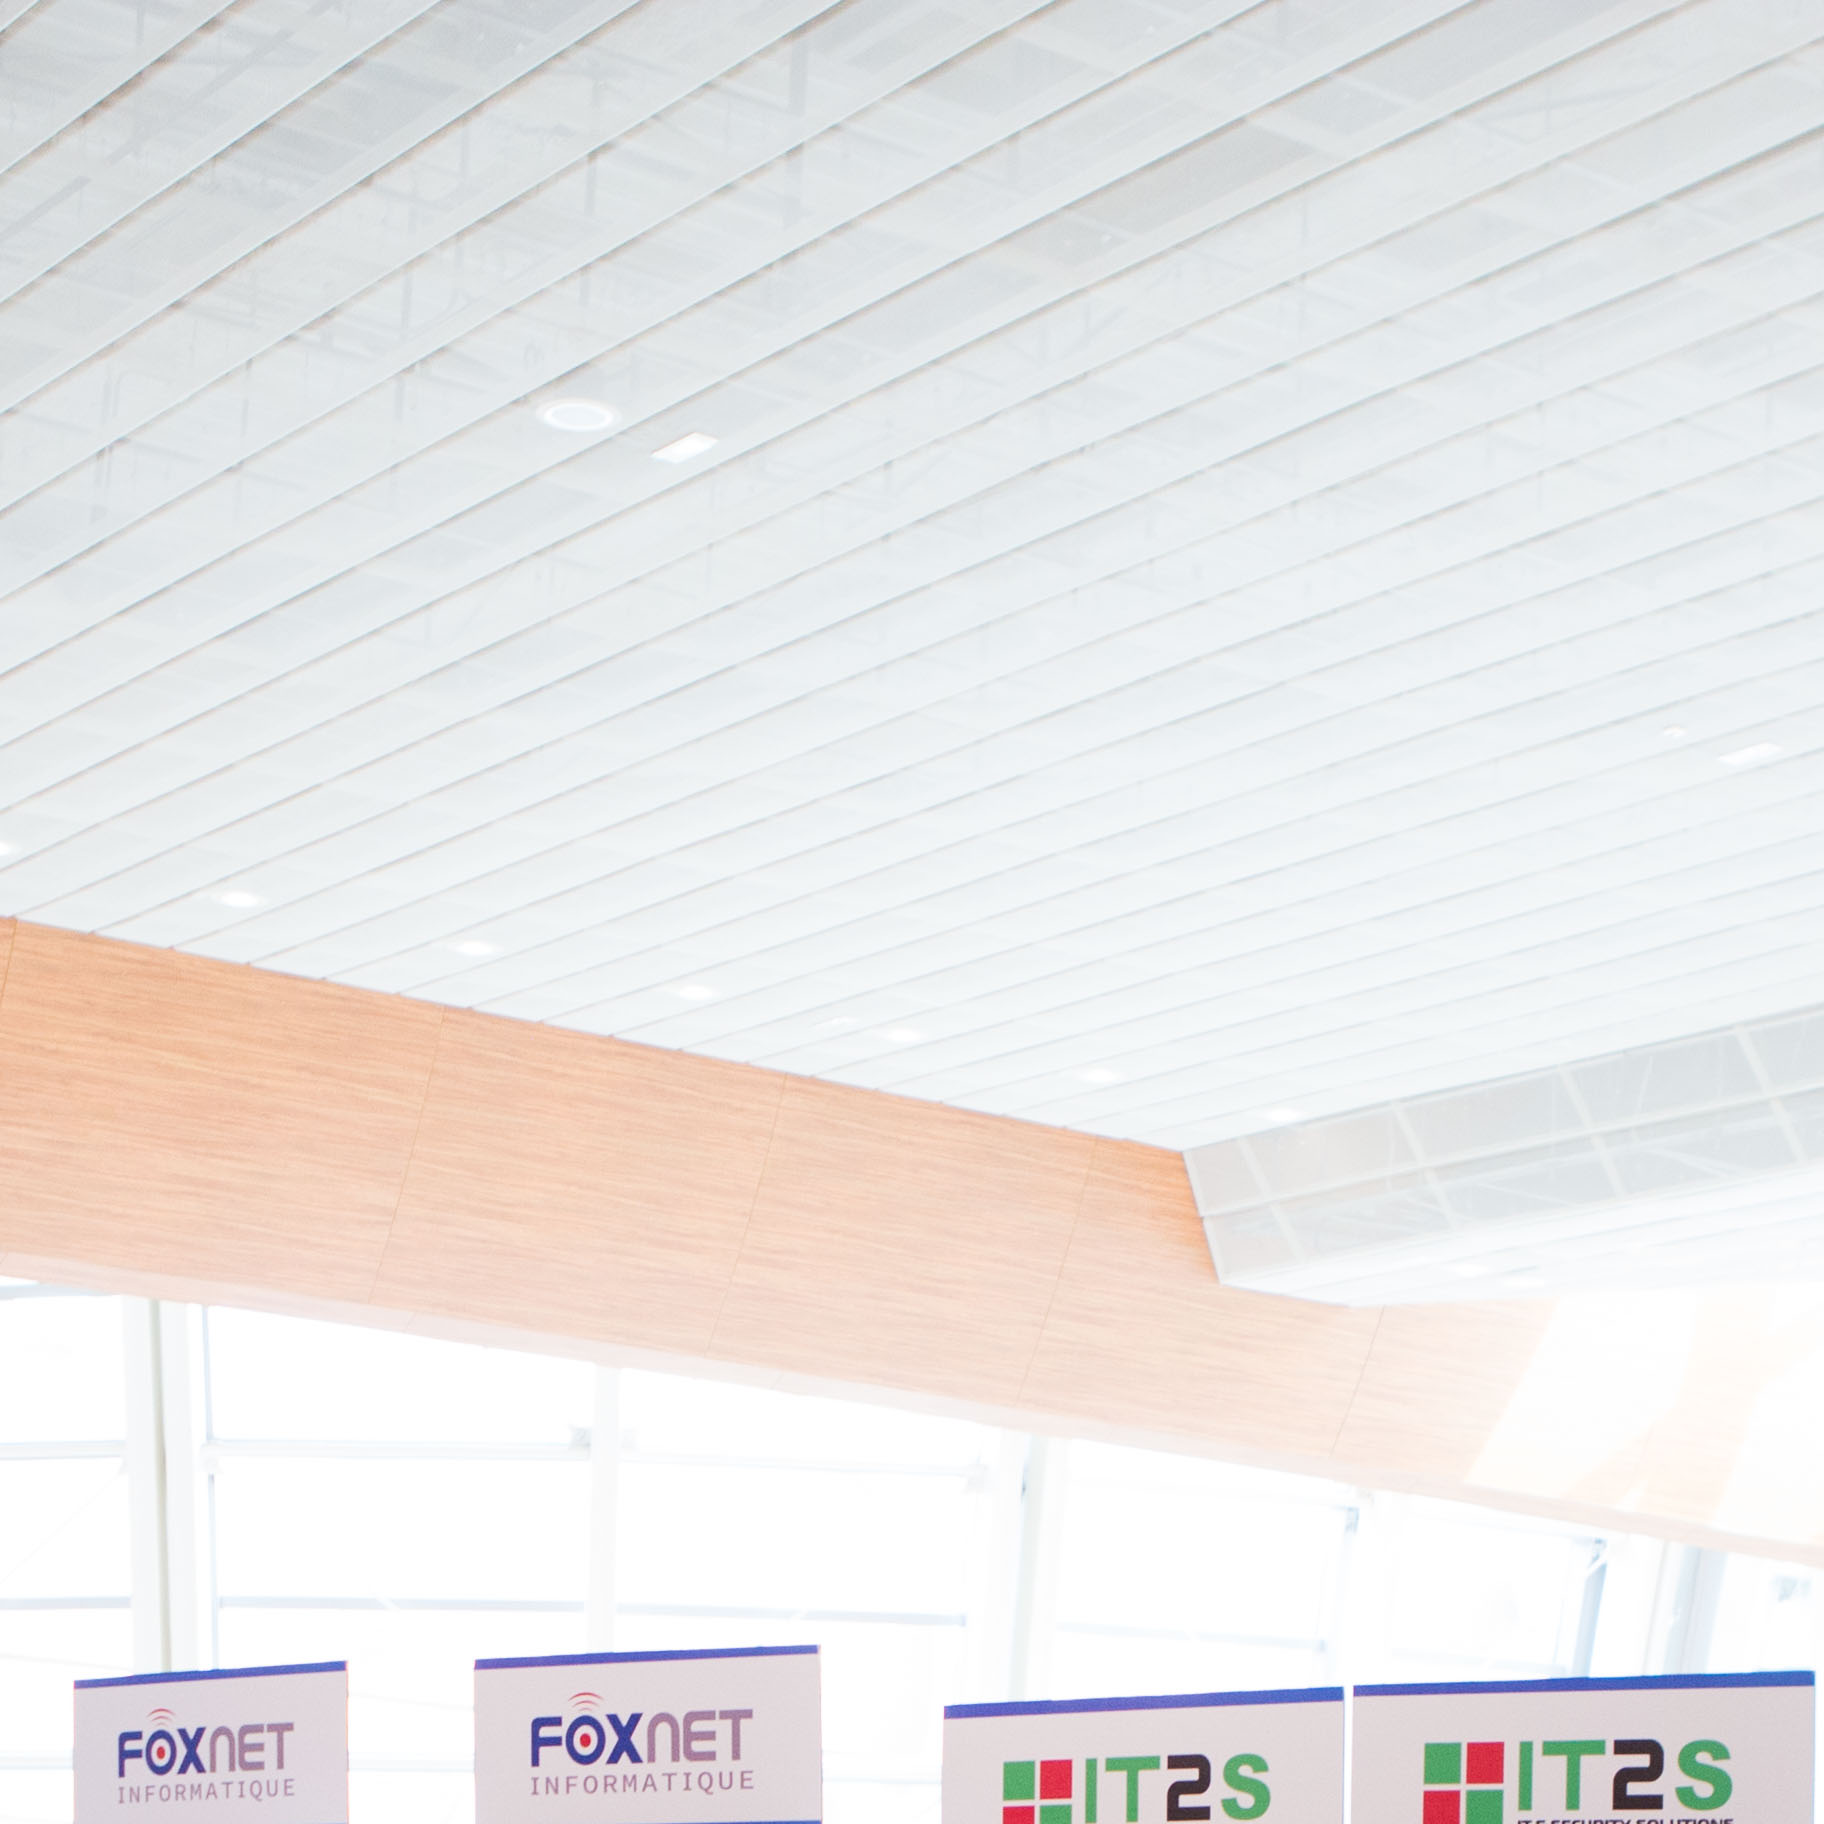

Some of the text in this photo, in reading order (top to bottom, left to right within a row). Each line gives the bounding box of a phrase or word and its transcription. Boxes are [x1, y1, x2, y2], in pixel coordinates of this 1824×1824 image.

[118, 1778, 296, 1804] INFORMATIQUE
[530, 1770, 755, 1796] INFORMATIQUE
[1084, 1753, 1272, 1824] IT2S
[1517, 1738, 1734, 1811] IT2S
